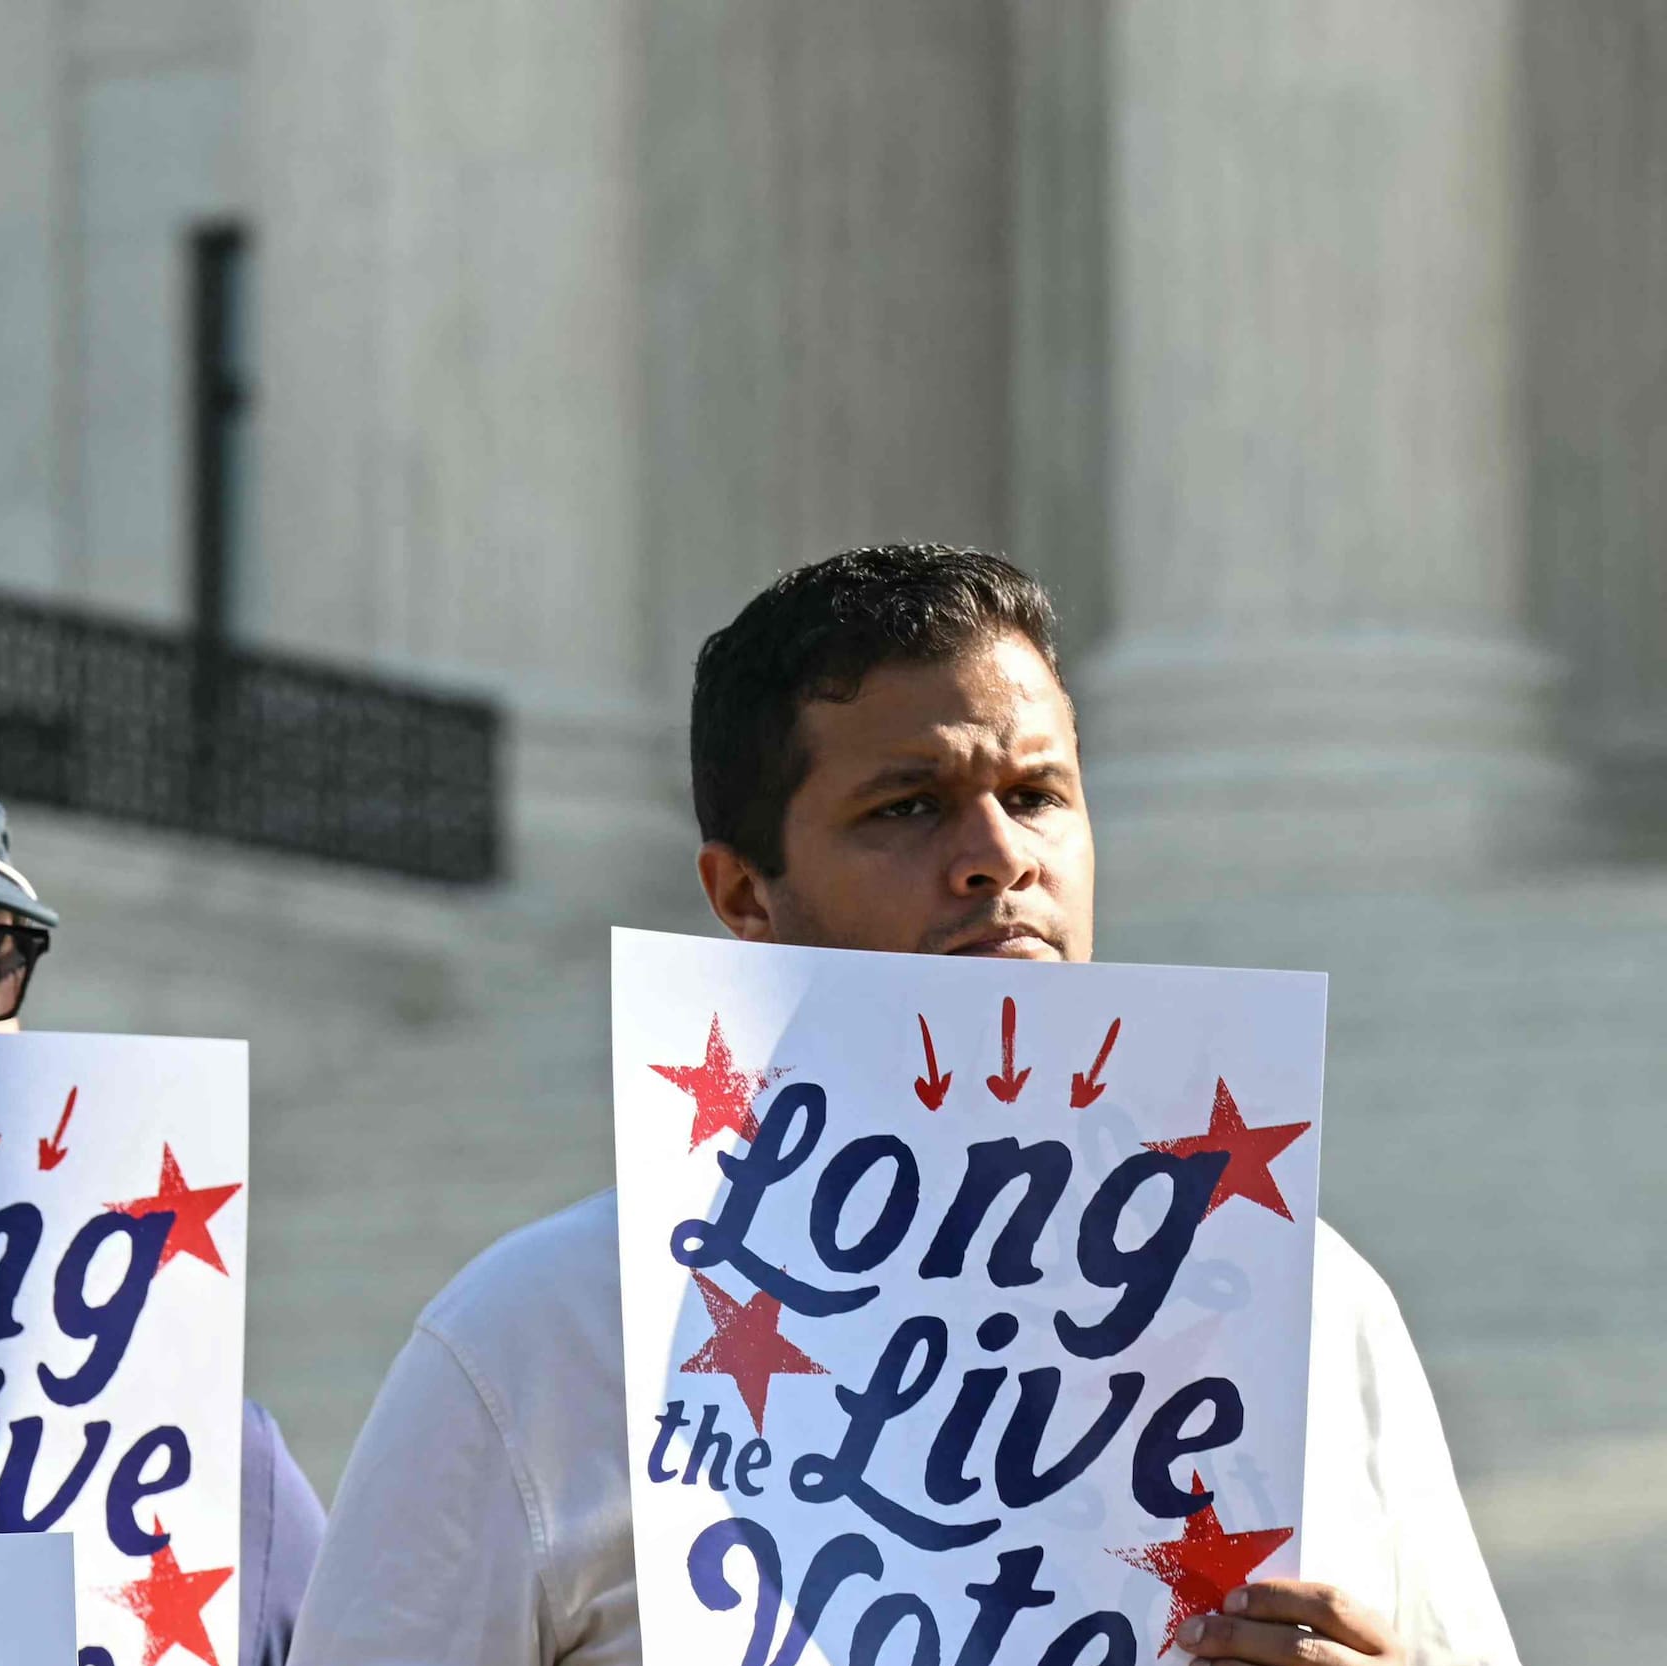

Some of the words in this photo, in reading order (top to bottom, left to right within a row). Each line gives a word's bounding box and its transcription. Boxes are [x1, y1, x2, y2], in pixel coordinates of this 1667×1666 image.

[670, 1082, 1231, 1360] Long
[647, 1400, 772, 1497] the
[789, 1312, 1245, 1552] Live
